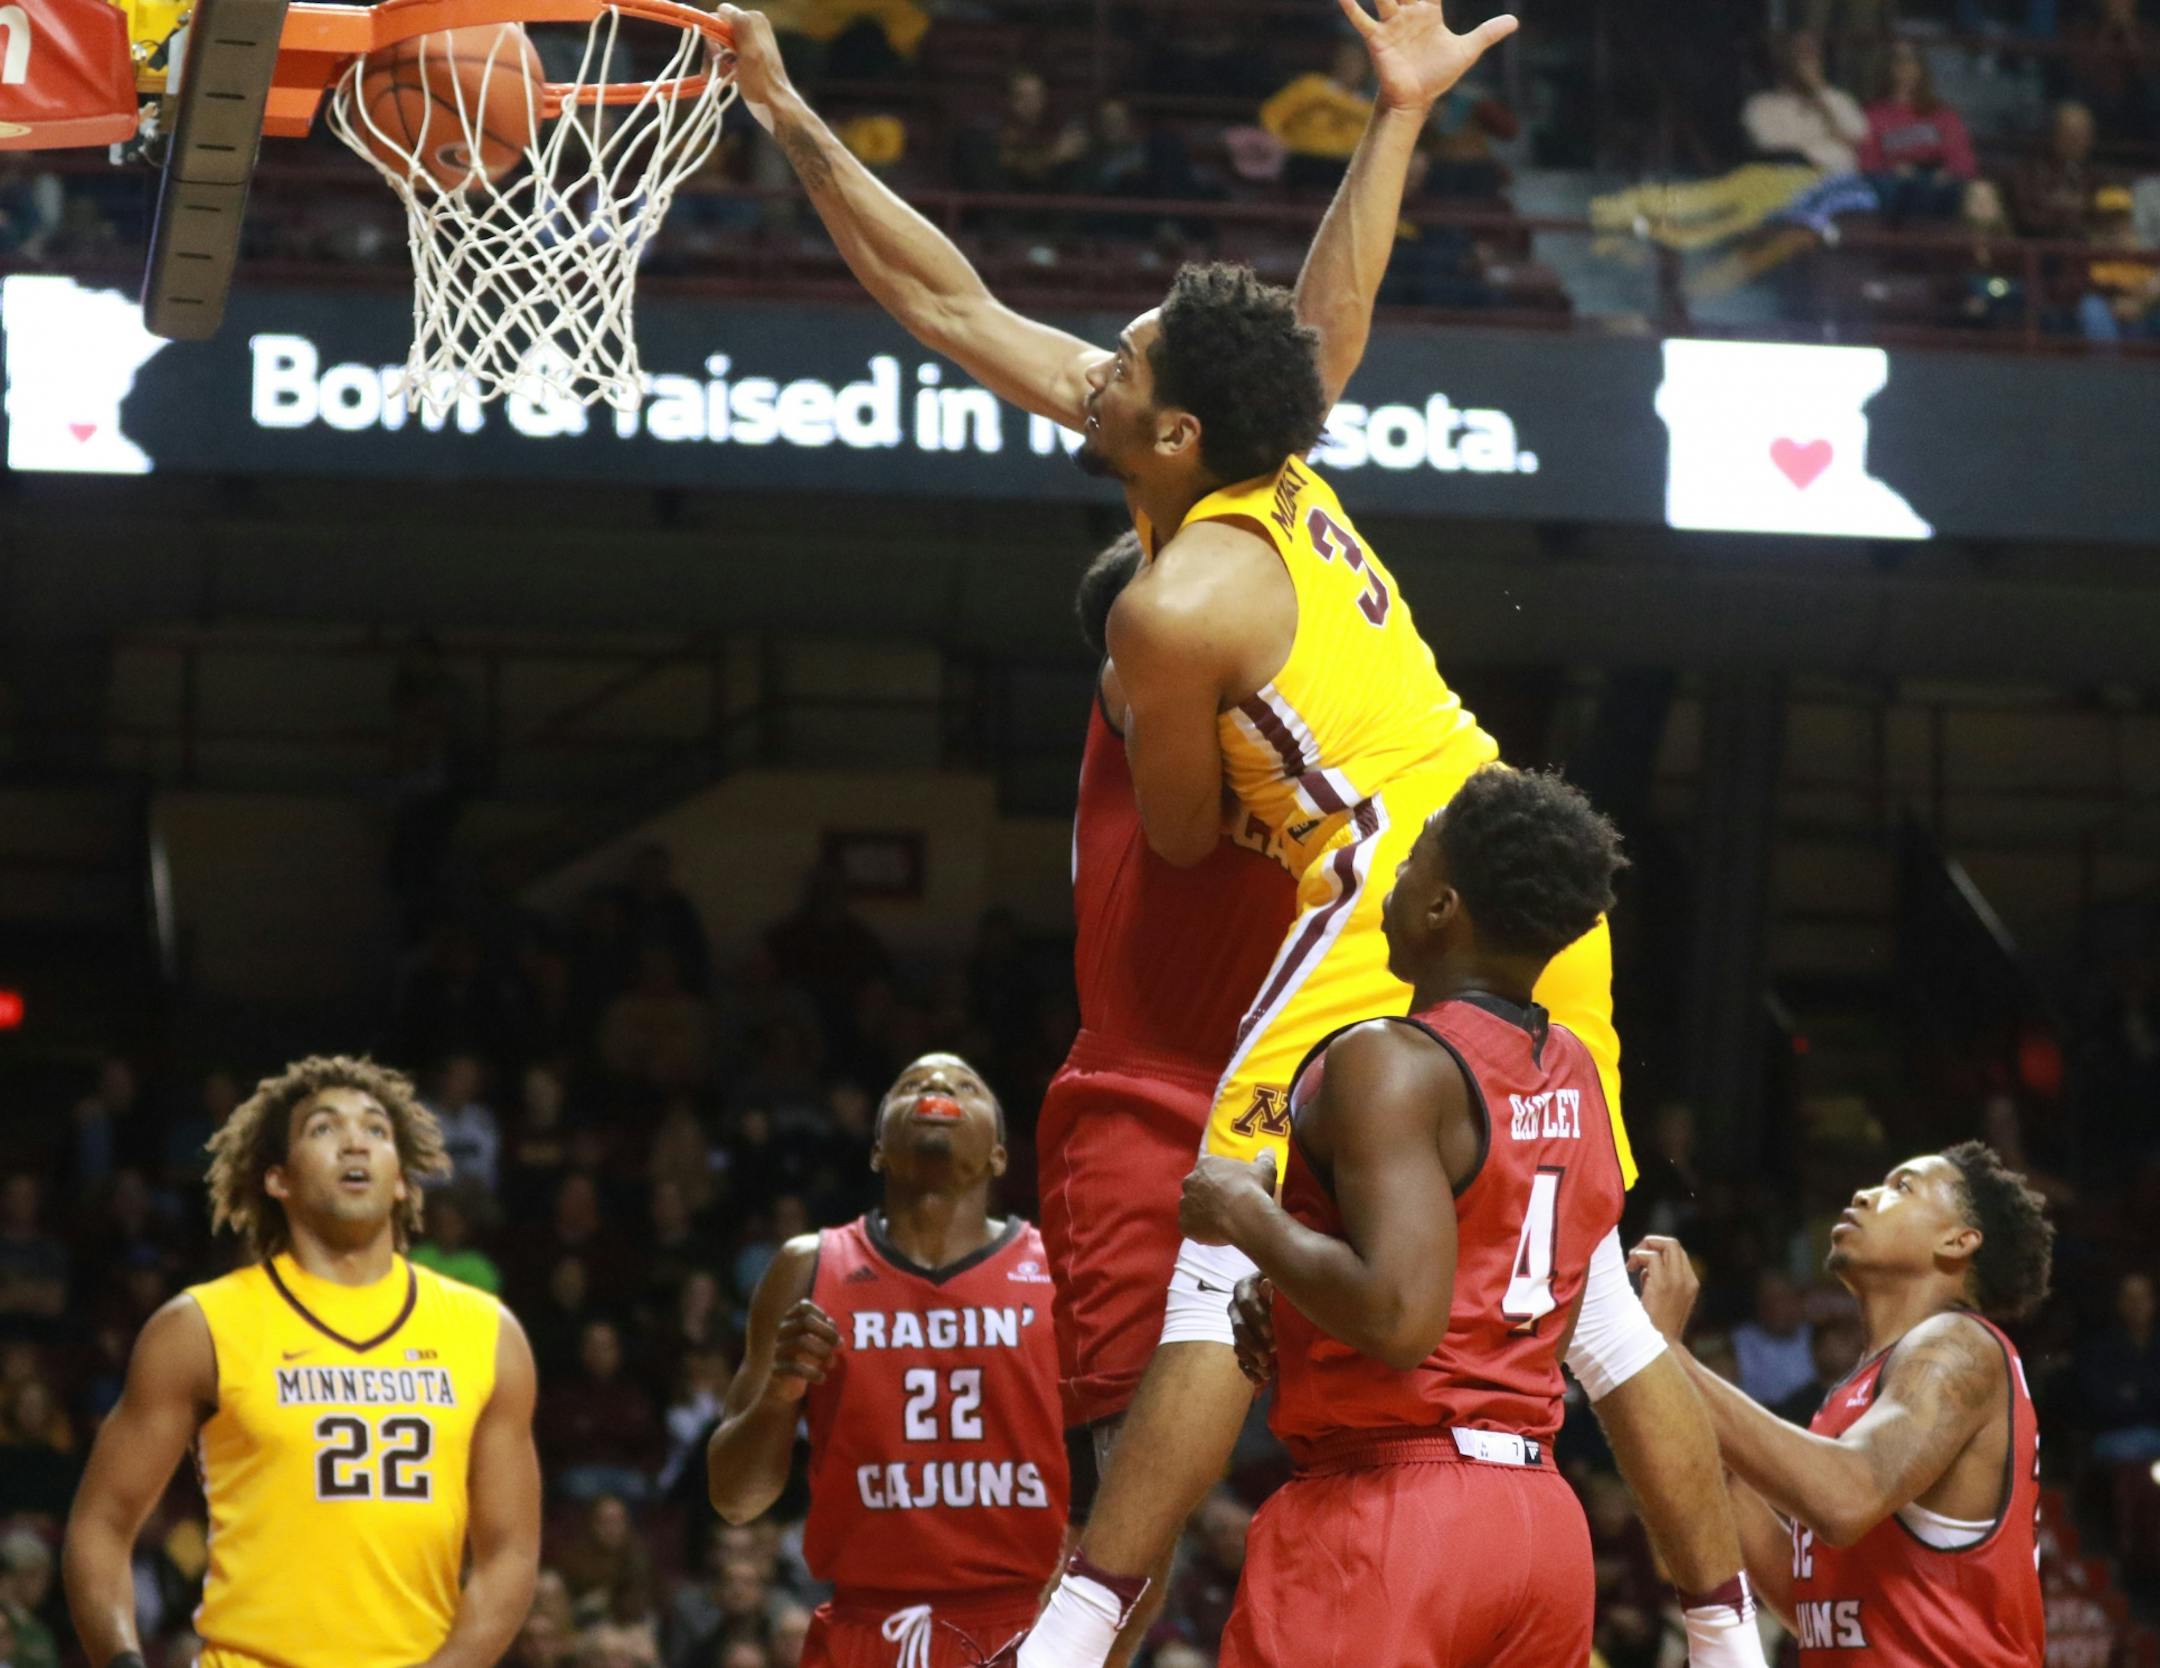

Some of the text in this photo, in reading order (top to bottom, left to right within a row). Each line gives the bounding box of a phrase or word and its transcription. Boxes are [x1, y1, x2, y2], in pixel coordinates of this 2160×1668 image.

[250, 333, 485, 434] Born
[505, 342, 588, 438] &
[612, 353, 902, 448] raised
[915, 361, 1003, 453] in
[1305, 505, 1389, 628] 3
[1500, 1165, 1566, 1336] 4
[852, 1304, 1035, 1350] RAGIN'
[276, 1367, 457, 1406] MINNESOTA
[904, 1367, 983, 1441] 22
[316, 1414, 433, 1501] 22
[856, 1461, 1049, 1509] CAJUNS
